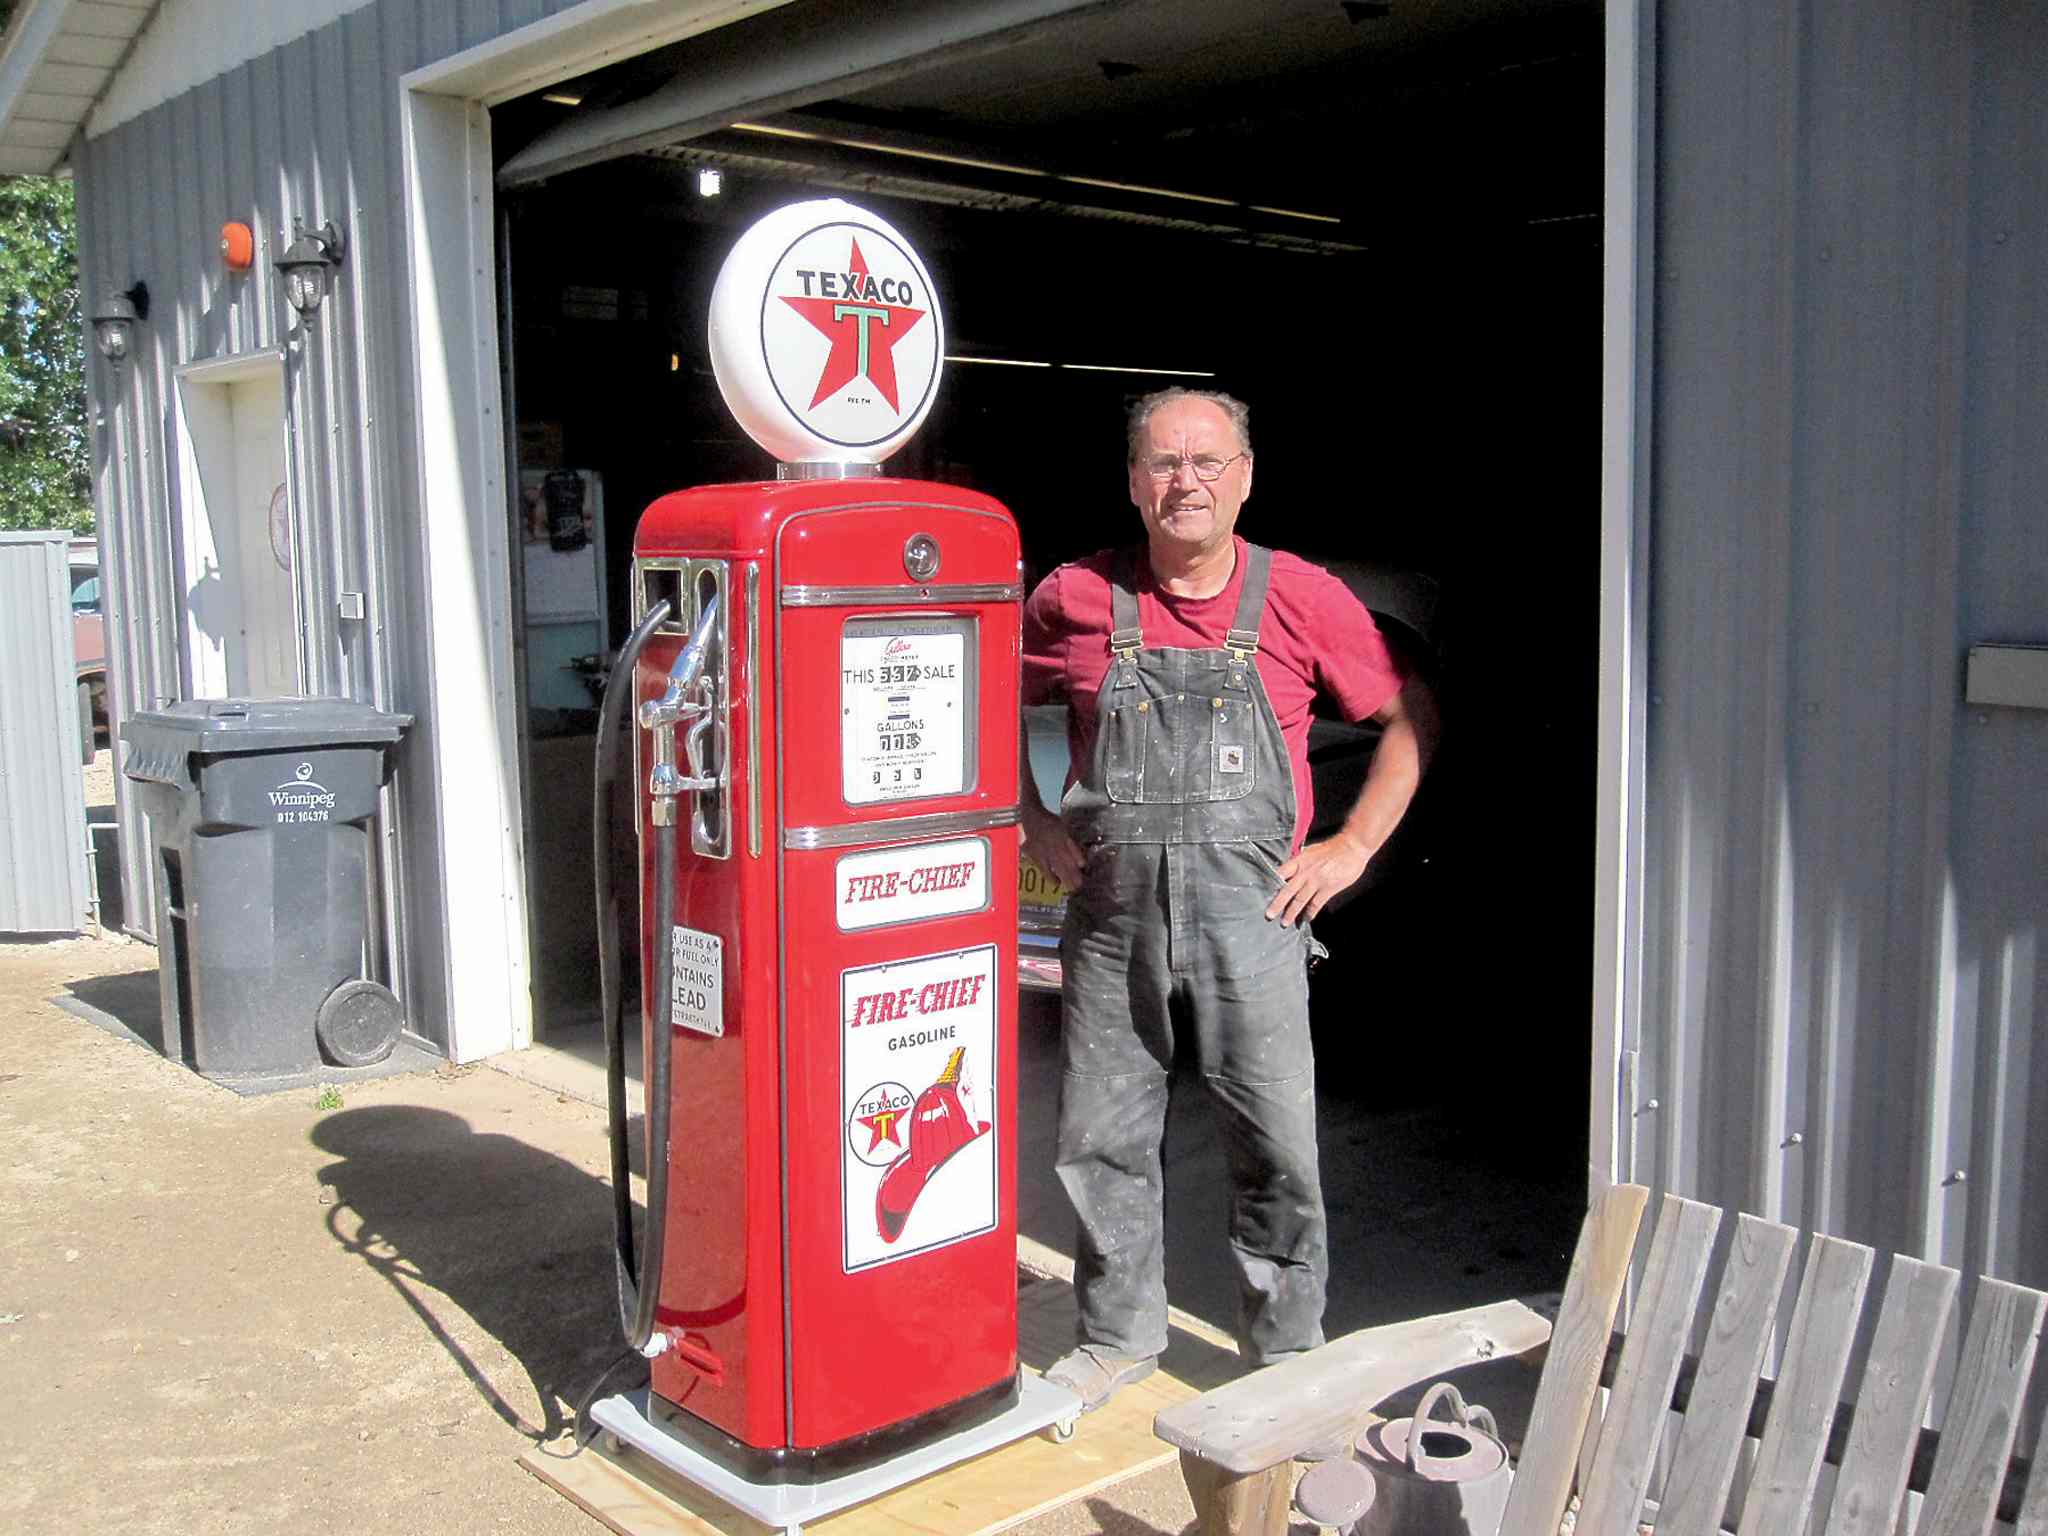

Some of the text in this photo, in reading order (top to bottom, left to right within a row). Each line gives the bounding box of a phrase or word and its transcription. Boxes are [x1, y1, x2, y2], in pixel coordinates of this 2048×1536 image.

[796, 269, 913, 305] TEXACO
[833, 303, 889, 377] T
[843, 668, 875, 685] THIS
[923, 664, 956, 680] SALE
[876, 719, 924, 732] GALLONS
[268, 791, 336, 808] Winnipeg
[845, 861, 976, 905] FIRE-CHIEF
[850, 973, 986, 1029] FIRE-CHIEF
[888, 1025, 956, 1052] GASOLINE
[859, 1094, 911, 1116] TEXACO
[872, 1112, 895, 1140] T
